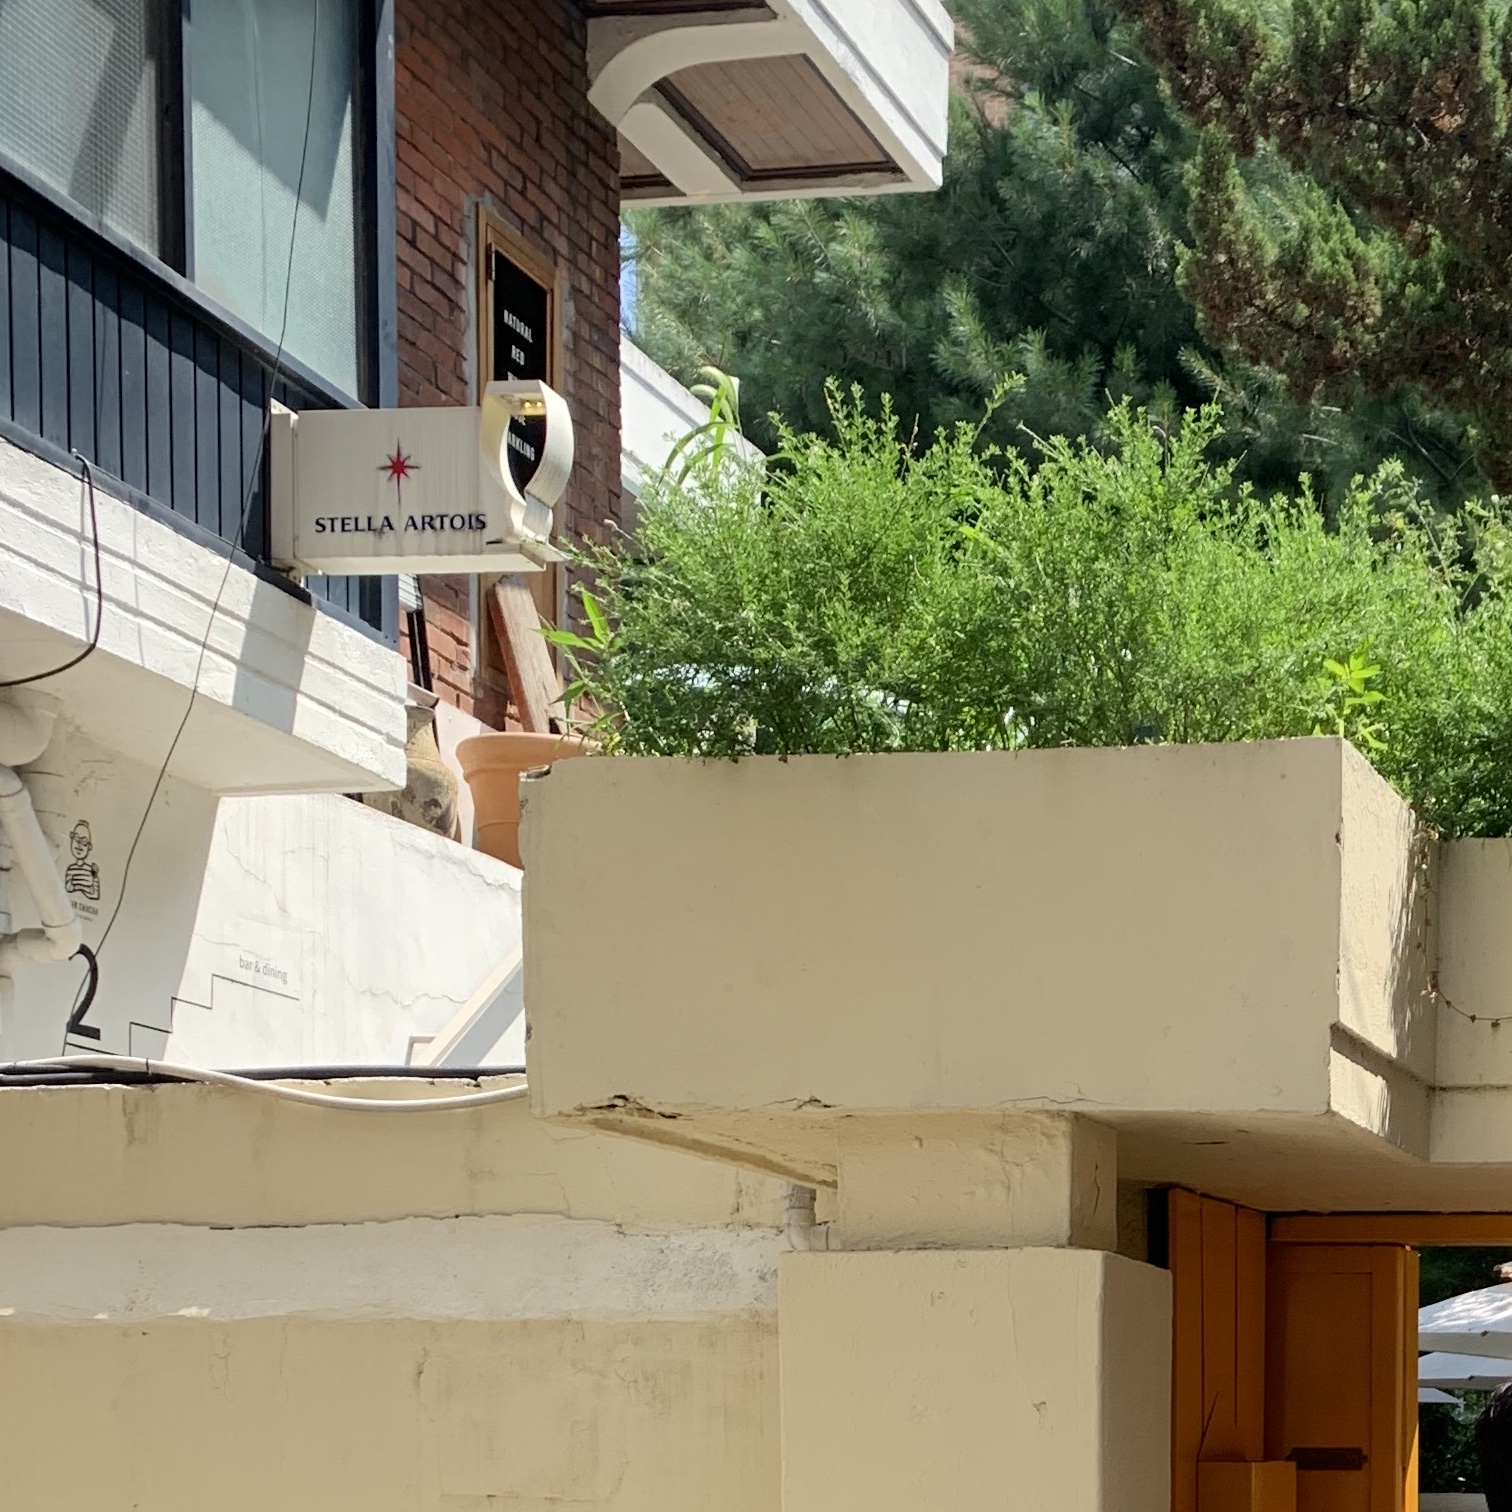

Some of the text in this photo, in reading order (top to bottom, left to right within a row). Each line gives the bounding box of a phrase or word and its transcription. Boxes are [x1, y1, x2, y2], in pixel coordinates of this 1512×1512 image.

[504, 309, 533, 343] NATURAL
[511, 345, 525, 366] RED
[507, 430, 536, 462] ARKLING
[315, 513, 487, 533] STELLA ARTOIS
[239, 954, 288, 985] bar & dining
